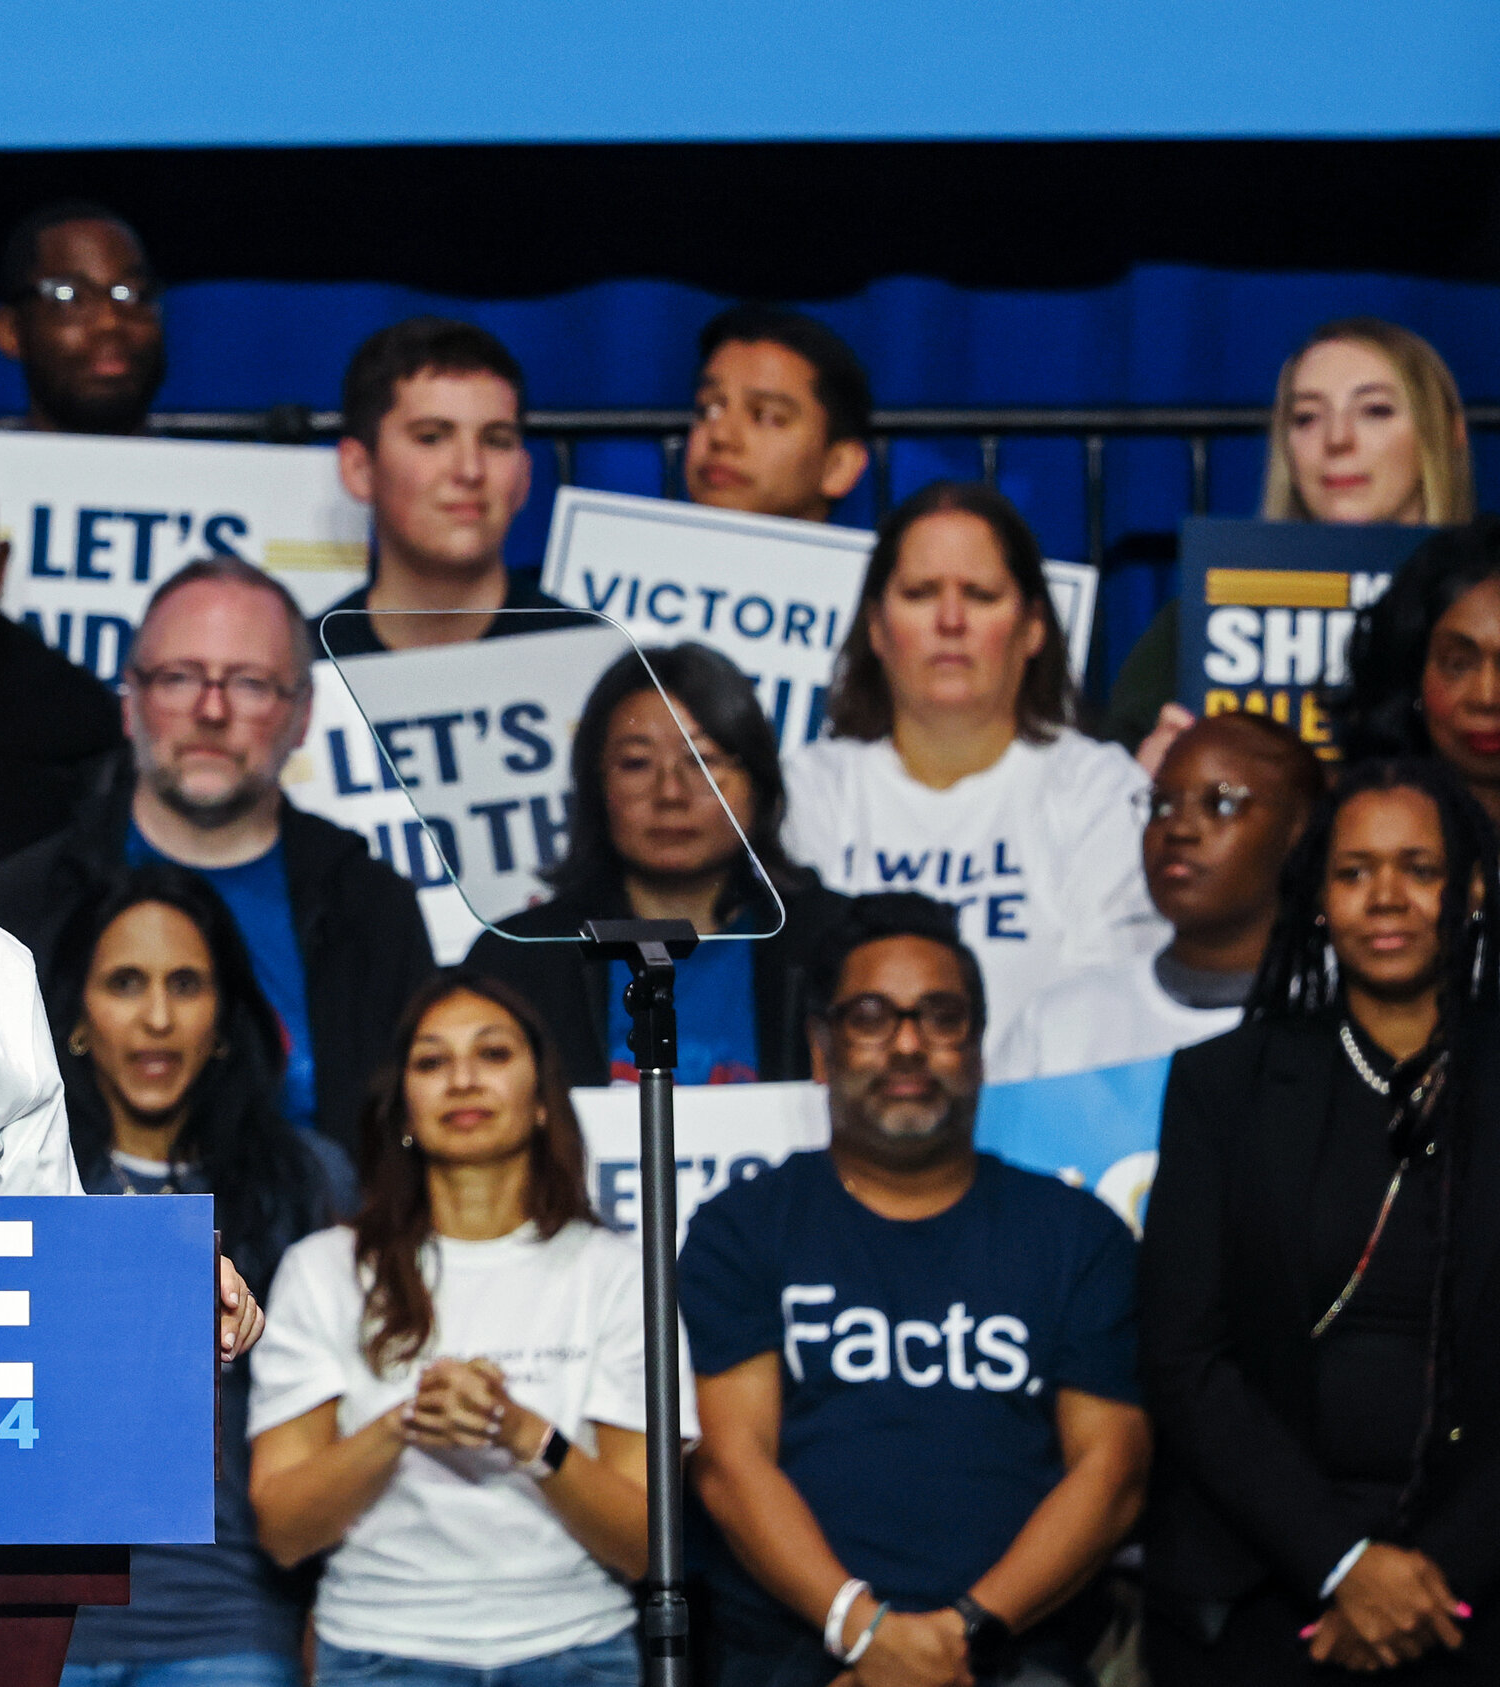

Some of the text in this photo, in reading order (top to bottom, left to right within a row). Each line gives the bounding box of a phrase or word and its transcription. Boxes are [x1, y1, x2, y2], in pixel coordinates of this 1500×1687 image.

[583, 569, 838, 648] VICTORI
[326, 702, 553, 797] LET'S
[844, 840, 1022, 886] I WILL
